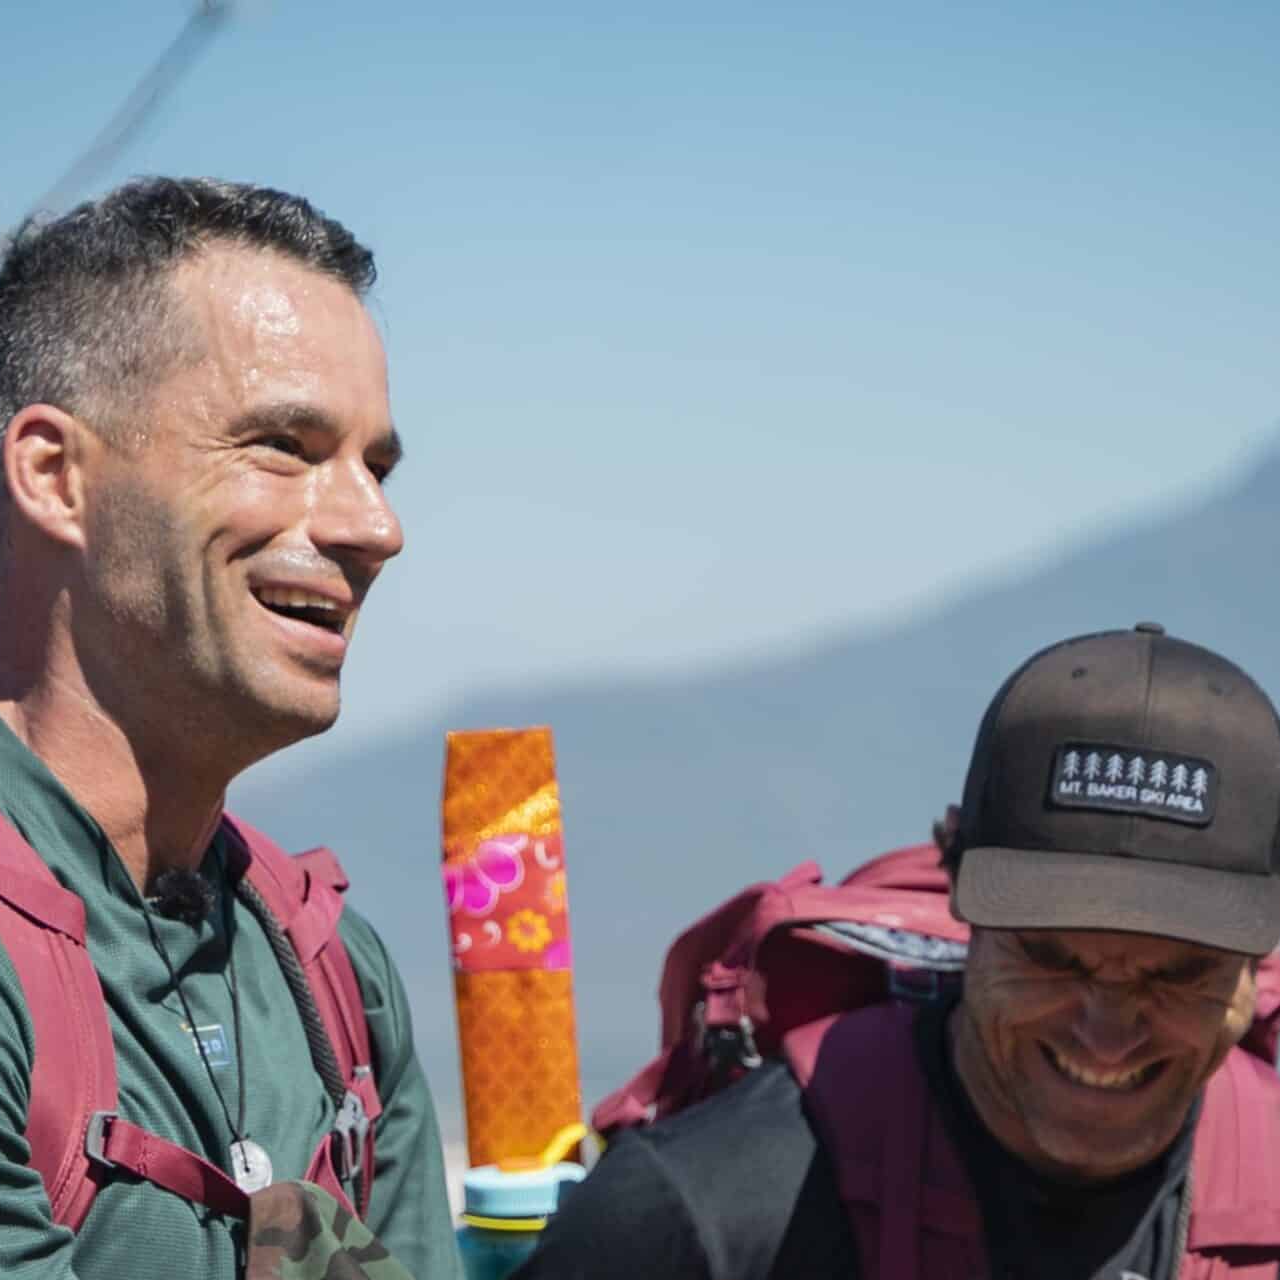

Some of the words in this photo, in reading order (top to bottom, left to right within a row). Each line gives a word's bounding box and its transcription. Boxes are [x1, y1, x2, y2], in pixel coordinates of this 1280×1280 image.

[1059, 781, 1082, 795] MT.
[1087, 782, 1137, 800] BAKER
[1139, 788, 1165, 804] SKI
[1166, 793, 1204, 812] AREA
